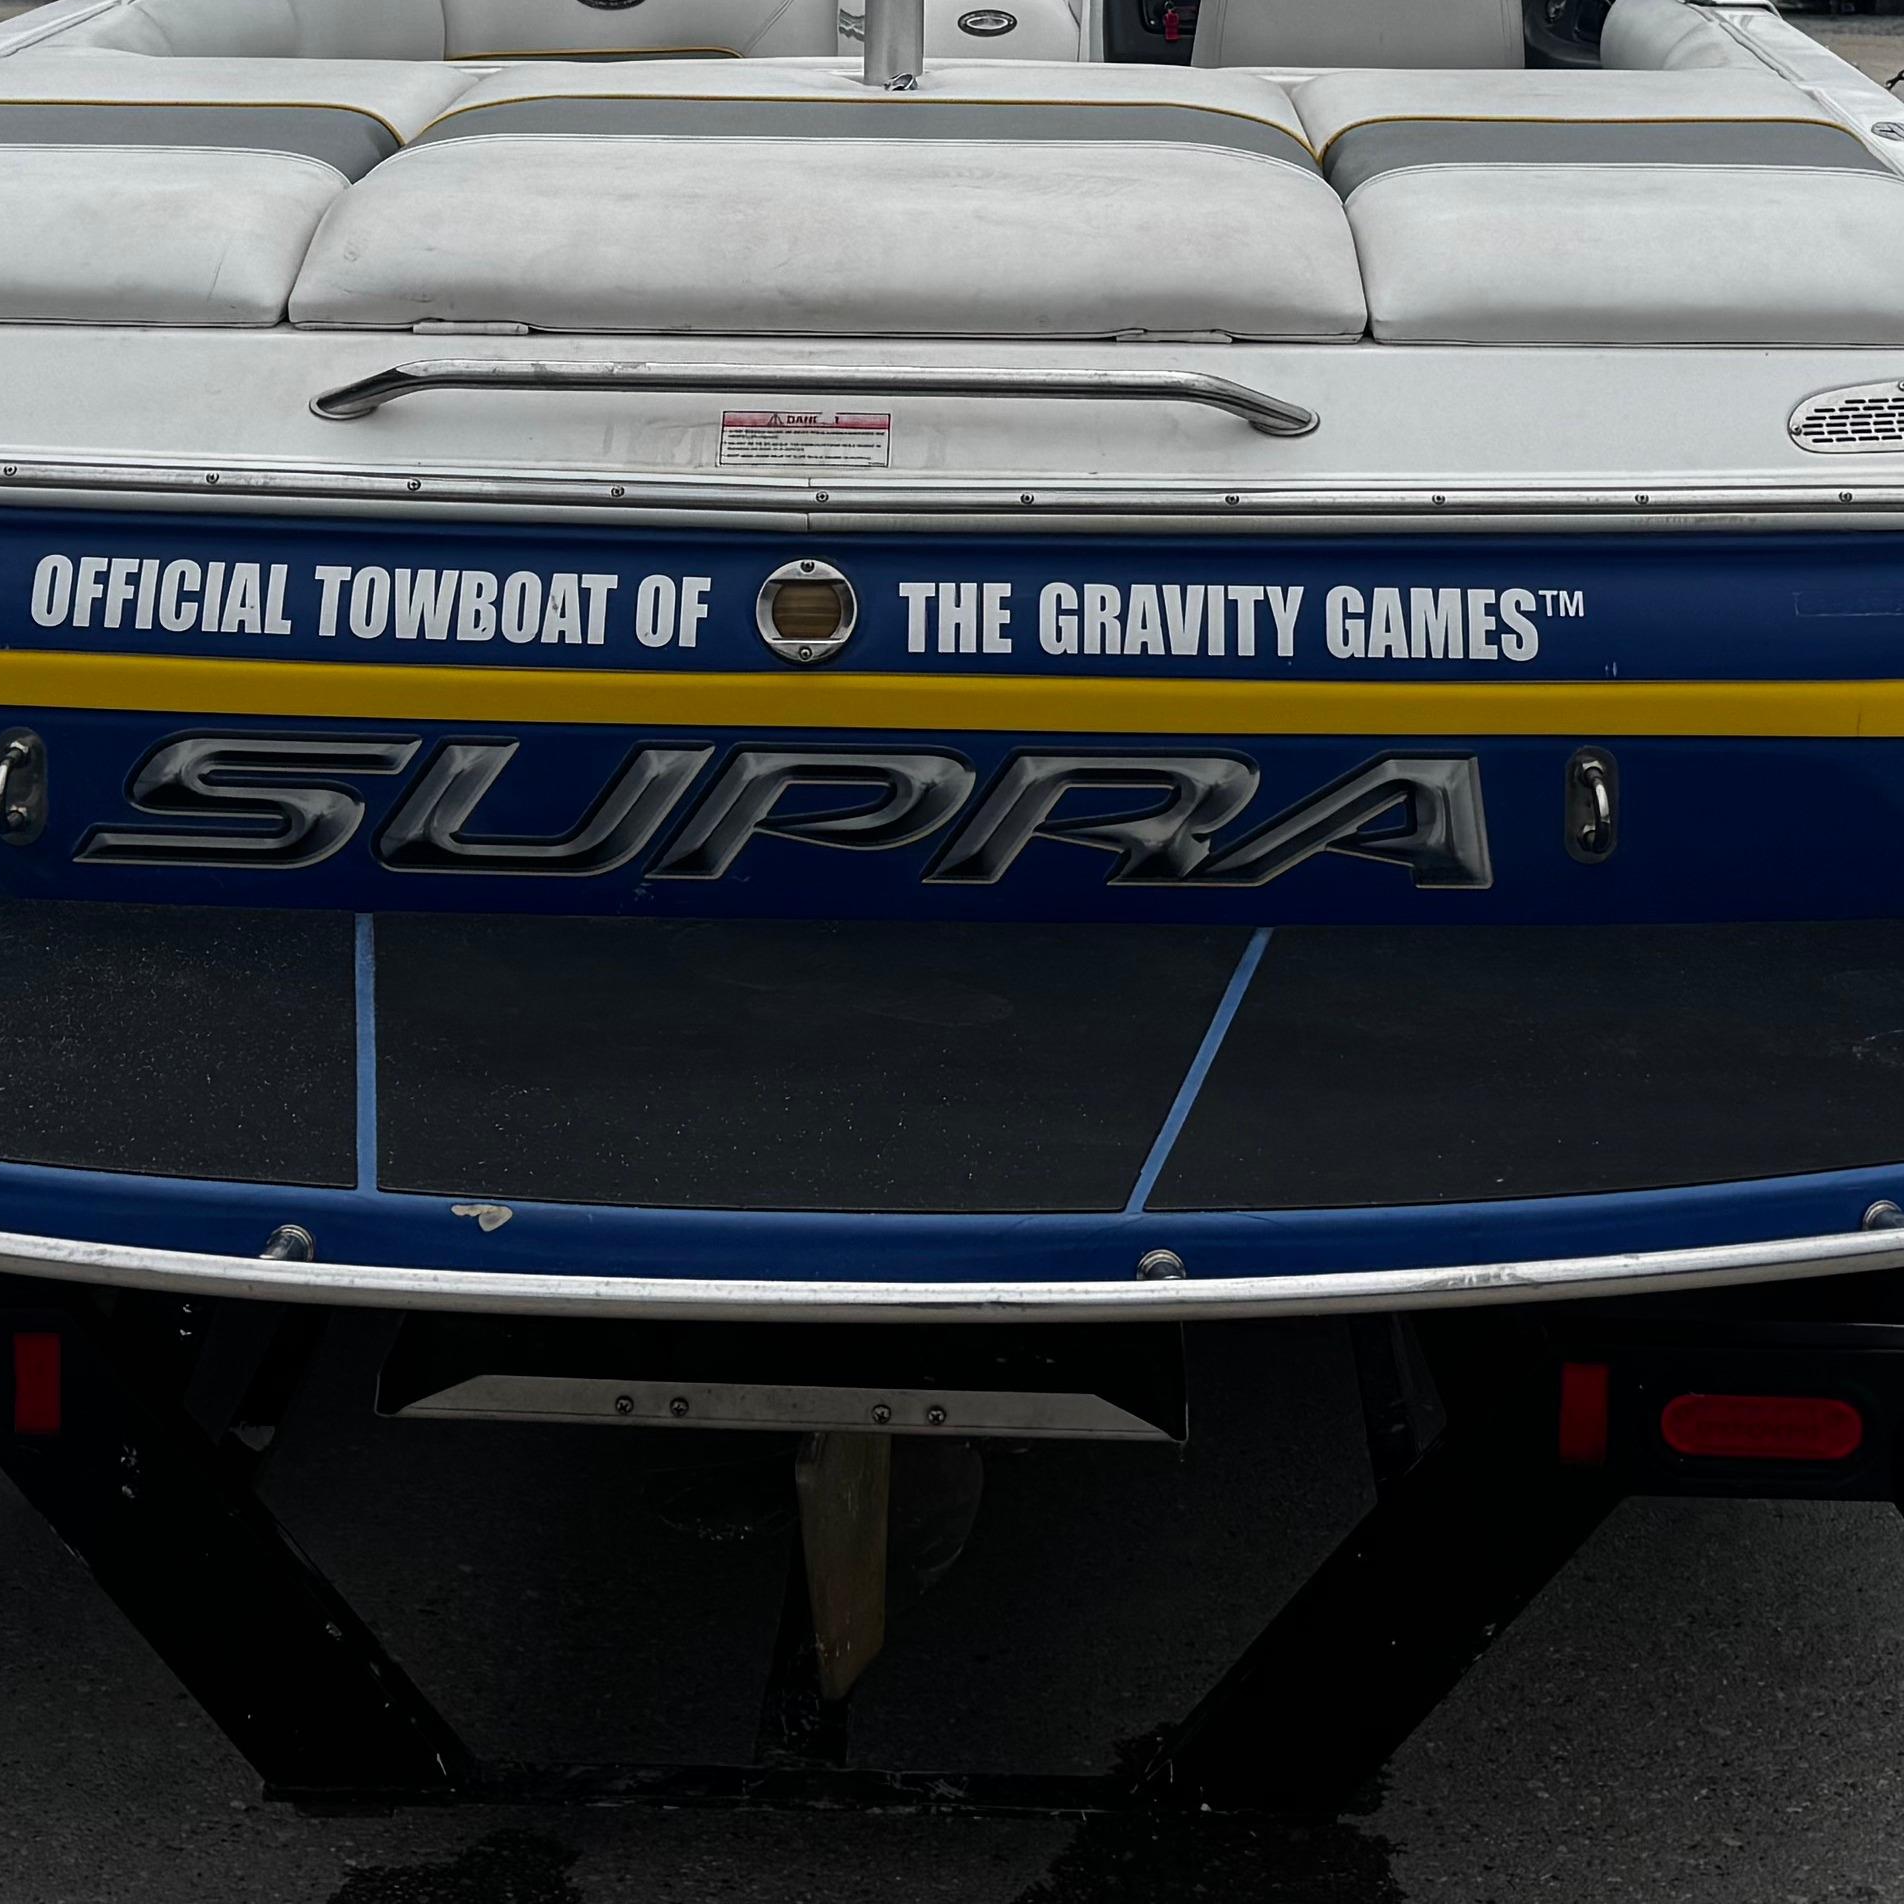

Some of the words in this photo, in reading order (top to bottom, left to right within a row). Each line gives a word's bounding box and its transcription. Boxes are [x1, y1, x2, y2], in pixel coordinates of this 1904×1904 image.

[30, 553, 294, 637] OFFICIAL
[314, 563, 621, 646] TOWBOAT
[635, 573, 713, 649] OF
[898, 581, 1012, 654] THE
[1038, 581, 1305, 658] GRAVITY
[73, 727, 1494, 890] SUPRA
